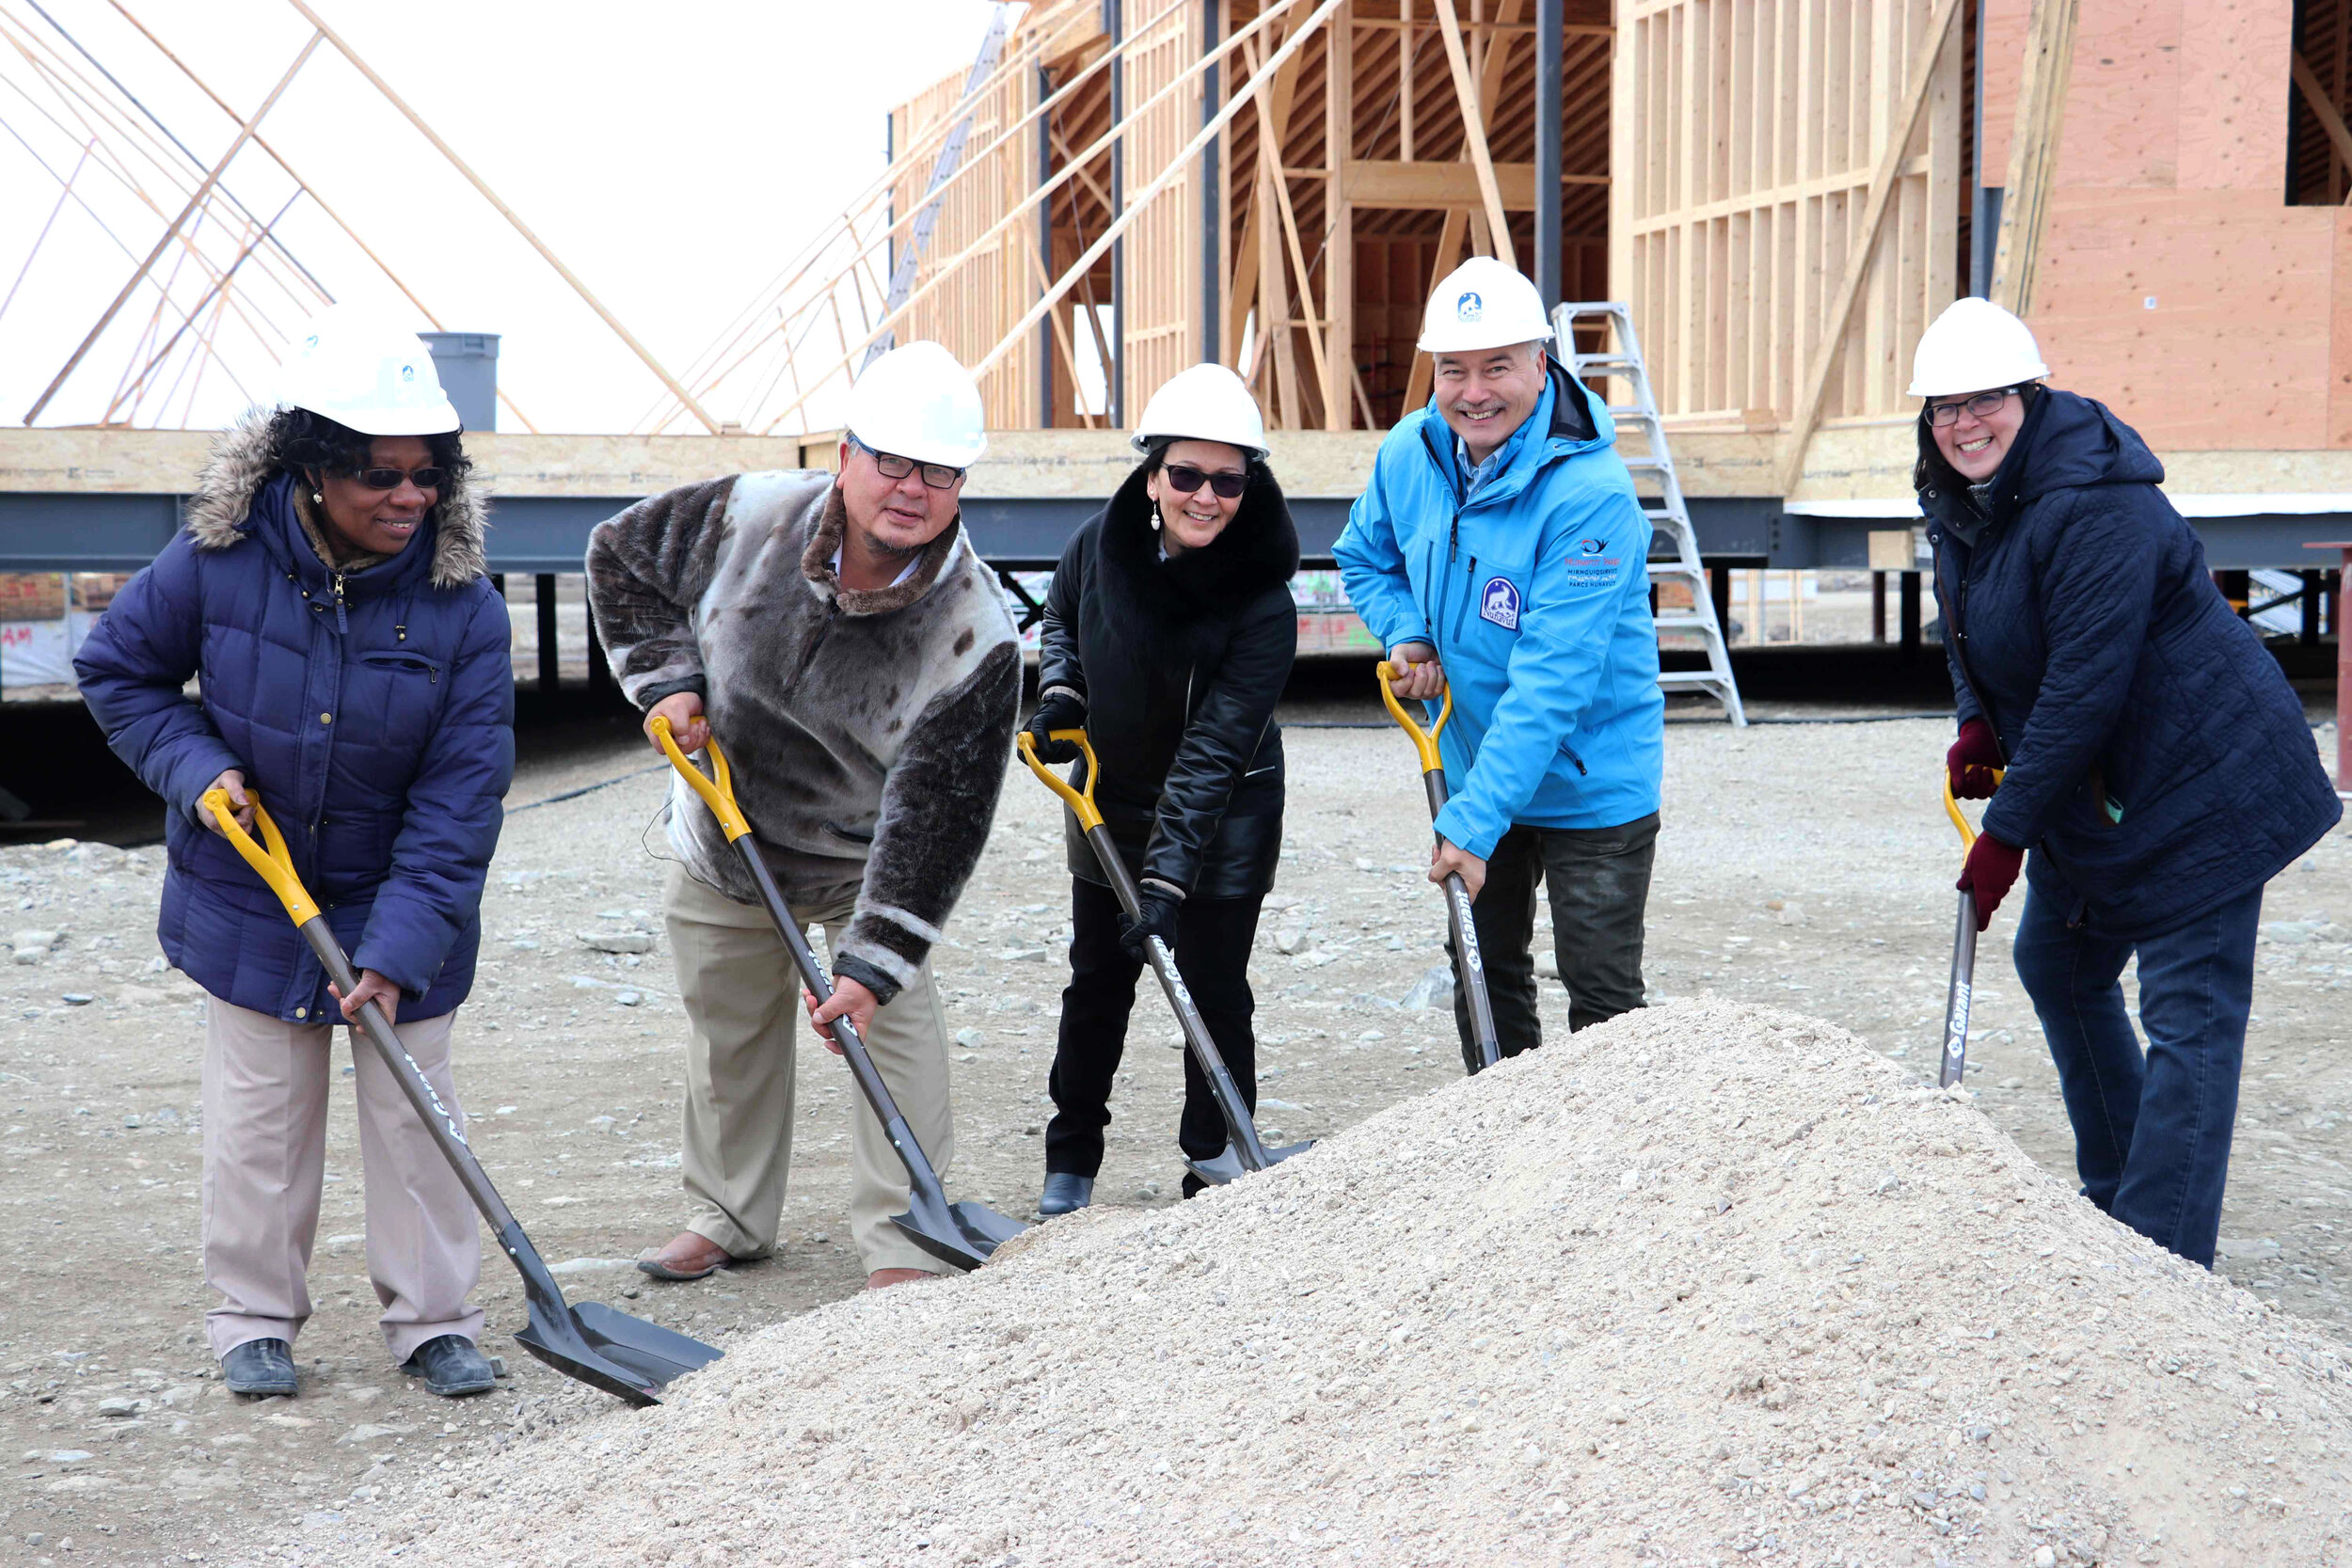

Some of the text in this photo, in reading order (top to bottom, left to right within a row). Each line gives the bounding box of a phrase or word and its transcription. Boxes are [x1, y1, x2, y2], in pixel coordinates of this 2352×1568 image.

[1483, 605, 1515, 626] Nunavut
[1454, 889, 1478, 947] Garant
[1949, 979, 1971, 1037] Garant
